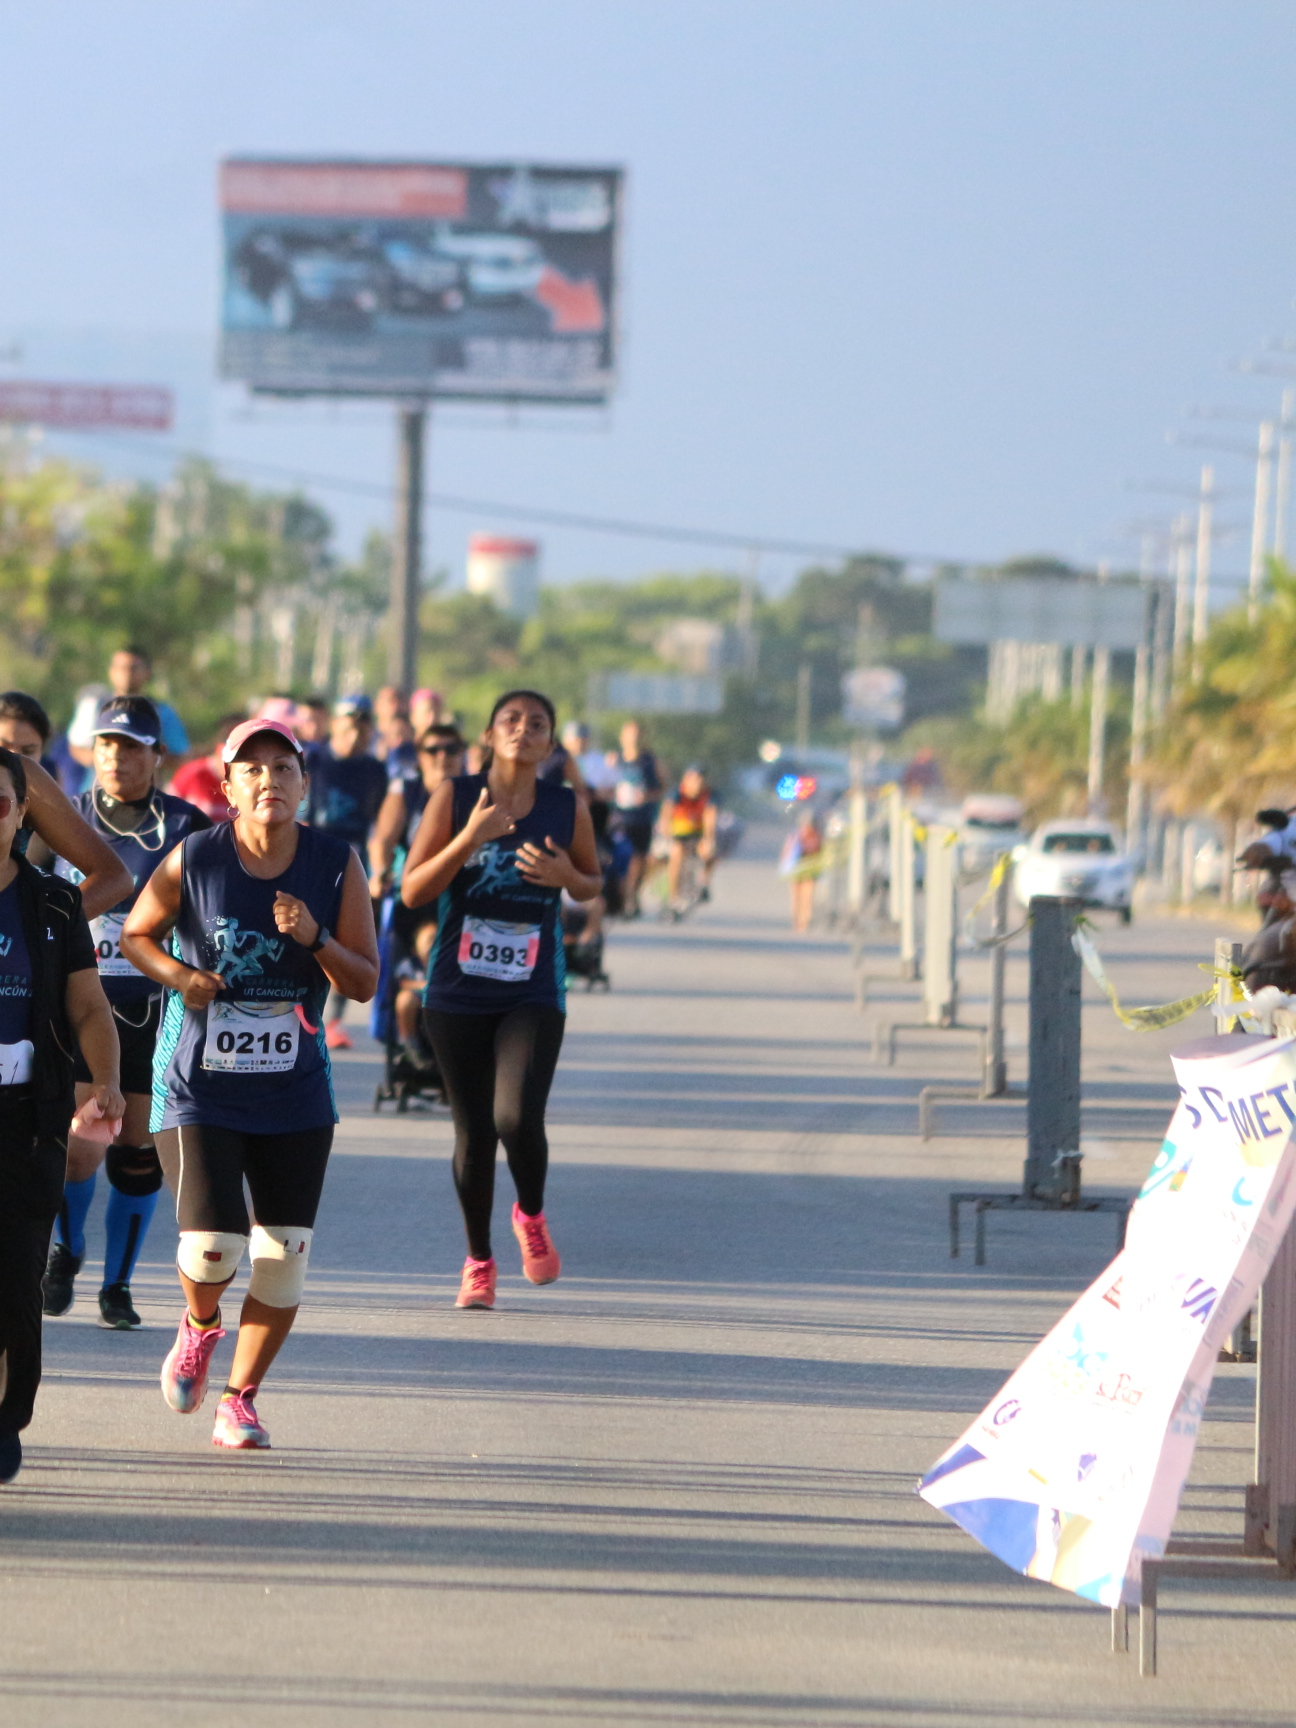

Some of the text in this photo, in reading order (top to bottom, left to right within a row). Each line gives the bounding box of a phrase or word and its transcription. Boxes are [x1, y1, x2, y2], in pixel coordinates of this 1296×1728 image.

[470, 942, 528, 967] 0393
[244, 987, 255, 996] UT
[256, 987, 295, 998] CANCÚN
[216, 1031, 292, 1055] 0216
